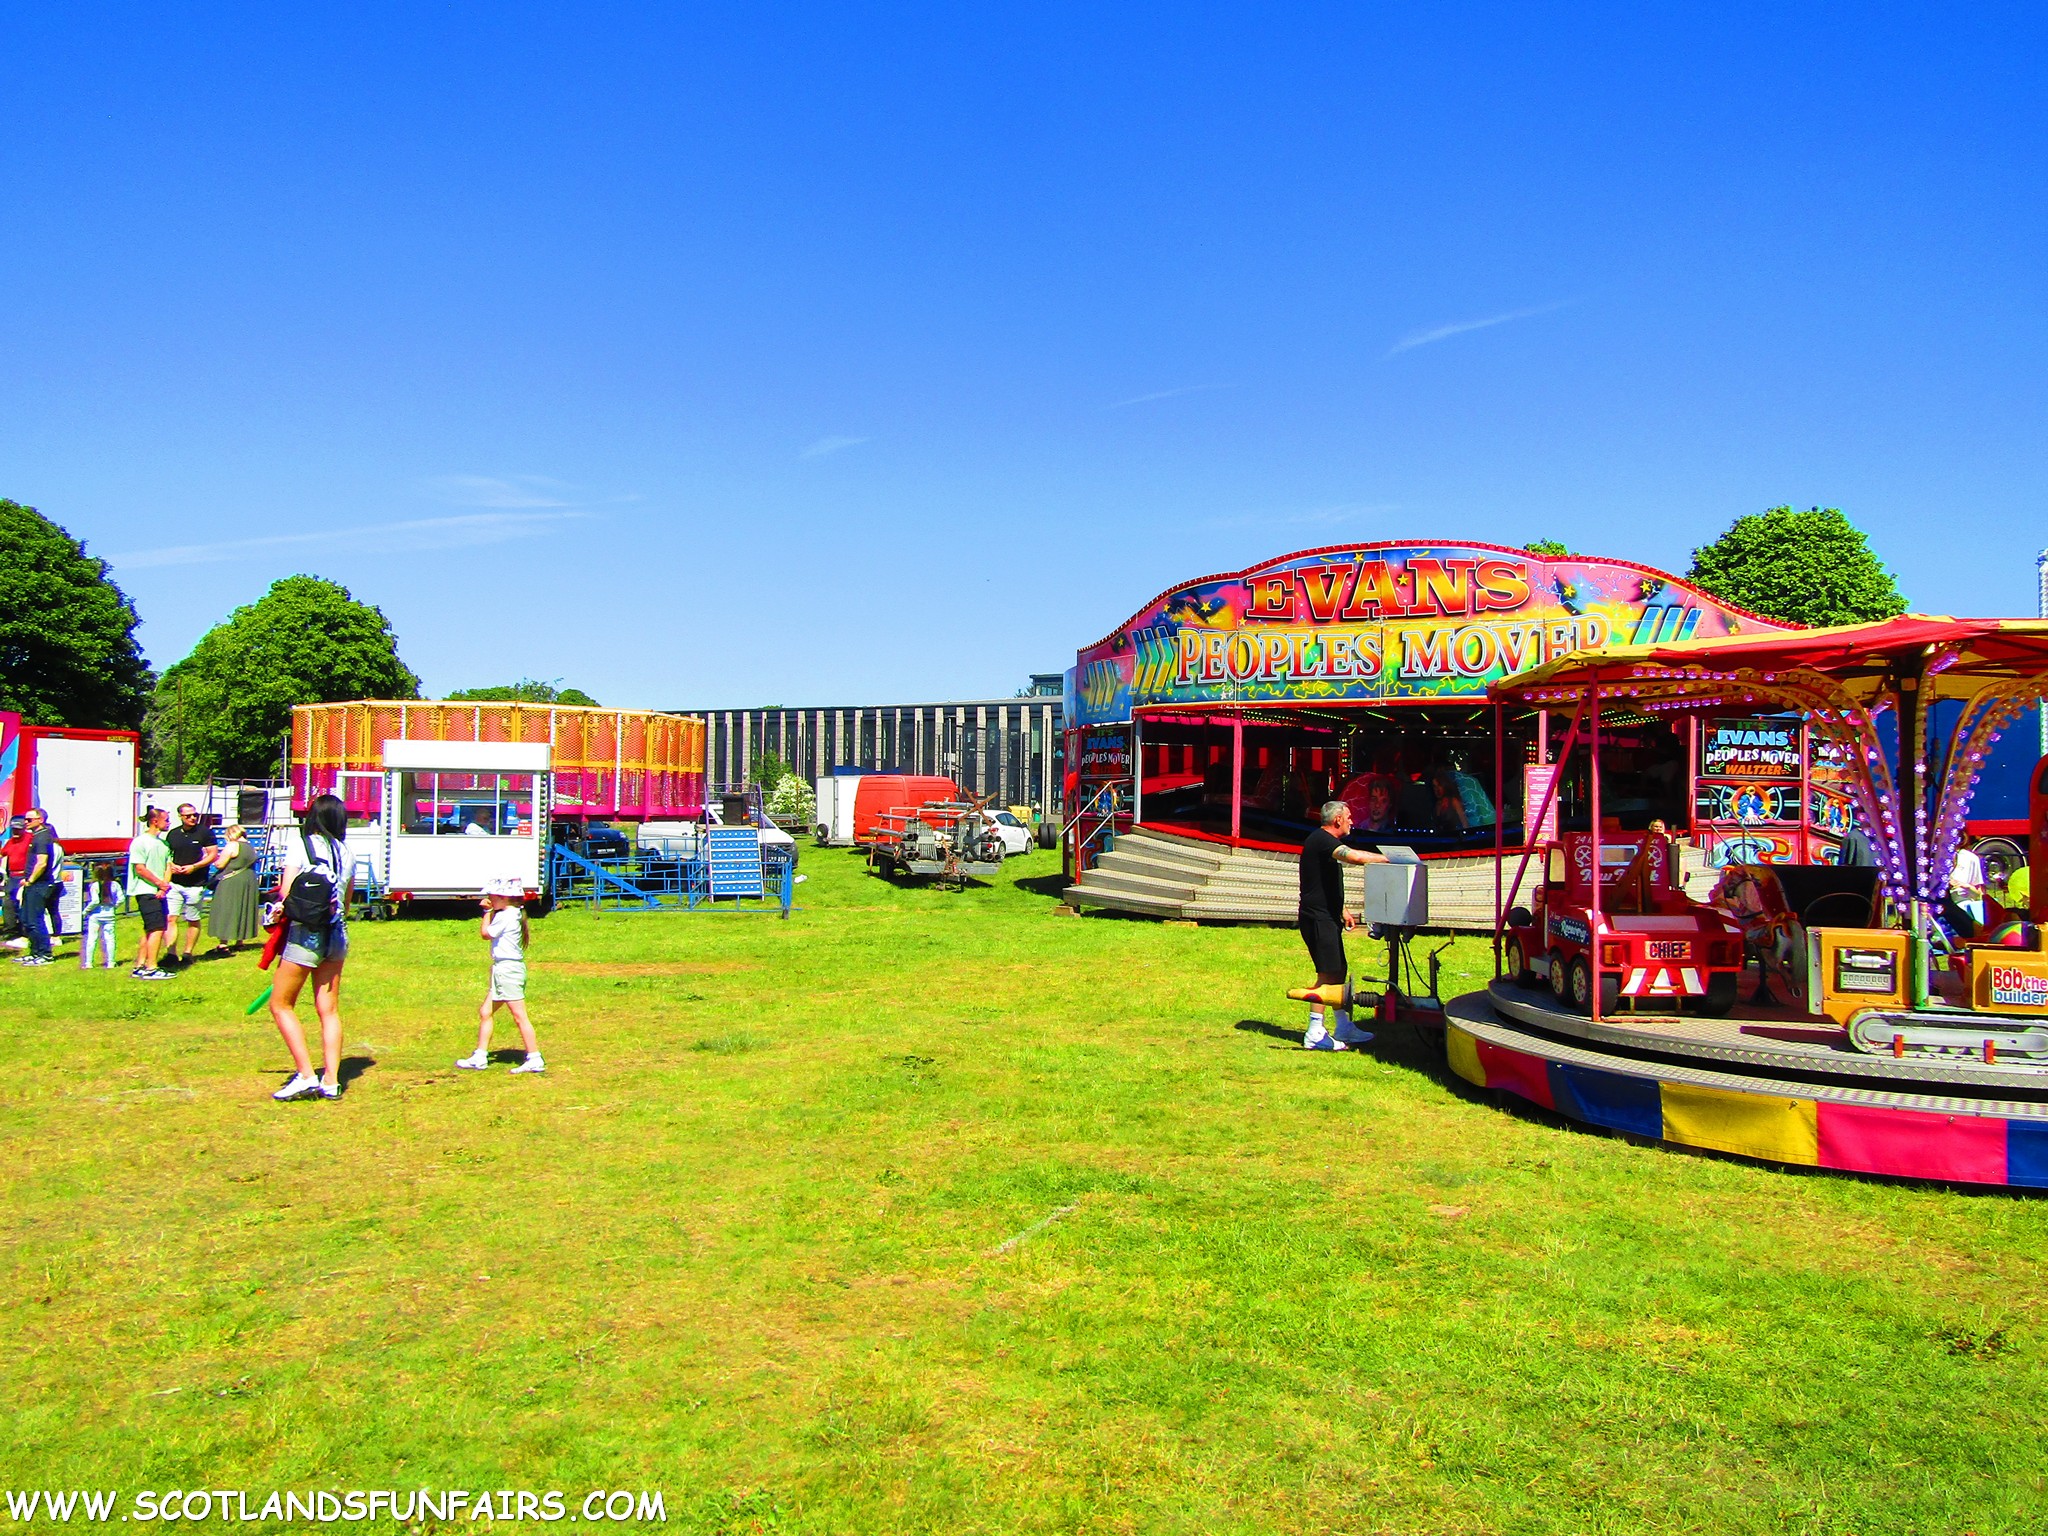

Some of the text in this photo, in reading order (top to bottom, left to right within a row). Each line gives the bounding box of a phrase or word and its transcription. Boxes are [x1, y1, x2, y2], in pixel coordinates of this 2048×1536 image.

[1246, 558, 1531, 620] EVANS
[1175, 626, 1383, 686] PEOPLES
[1737, 721, 1768, 730] IT'S
[1087, 735, 1124, 749] EVANS
[1717, 729, 1789, 746] EVANS
[1081, 752, 1130, 766] PEOPLES MOVER
[1706, 747, 1760, 765] PEOPLES
[1760, 749, 1800, 765] MOVER
[1725, 764, 1783, 775] WALTZER
[1649, 942, 1687, 959] CHIEF
[1993, 967, 2048, 990] Bob the
[1993, 989, 2048, 1004] builder
